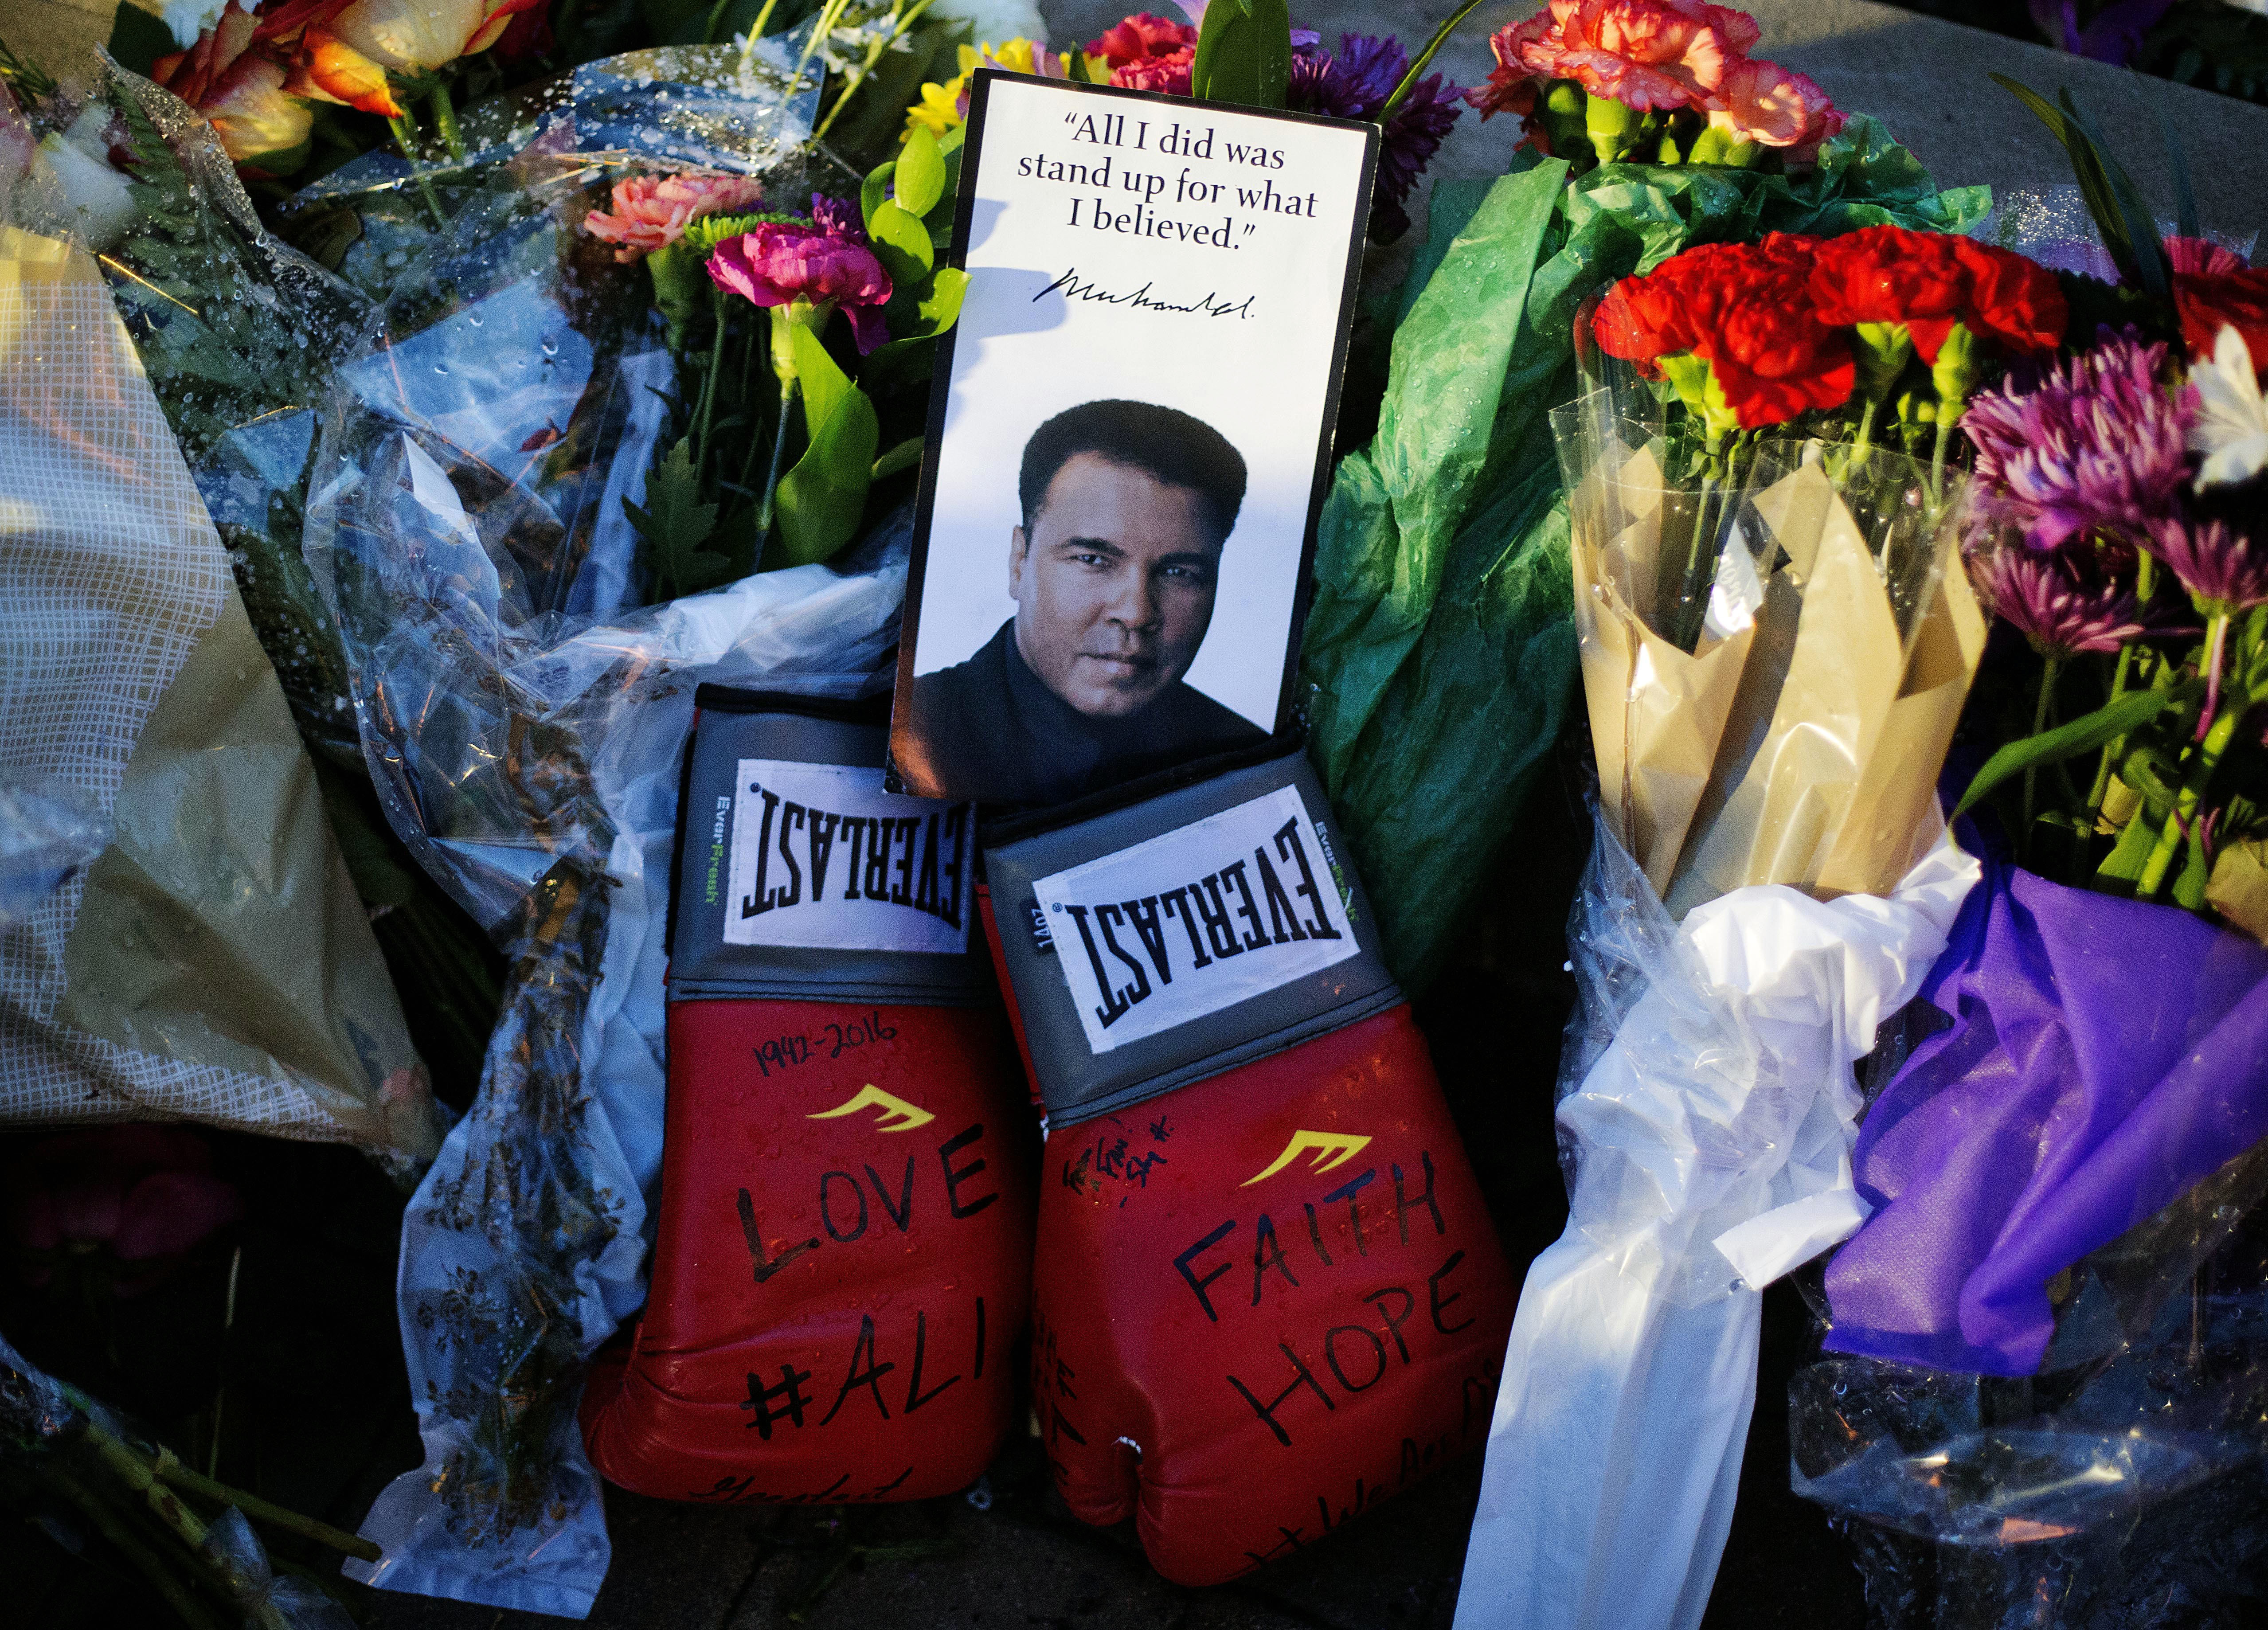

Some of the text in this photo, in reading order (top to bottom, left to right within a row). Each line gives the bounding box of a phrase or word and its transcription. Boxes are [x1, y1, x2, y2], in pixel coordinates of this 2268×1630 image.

[1018, 153, 1319, 217] stand up for what
[1067, 198, 1083, 226] I
[1134, 121, 1150, 150] I
[1159, 124, 1214, 160] did
[1226, 143, 1285, 169] was
[741, 788, 971, 930] EVERLAST
[1066, 816, 1341, 1029] EVERLAST
[752, 1010, 897, 1078] 1942-2016
[736, 1124, 998, 1282] LOVE
[1173, 1151, 1445, 1322] FAITH
[1227, 1250, 1476, 1446] HOPE
